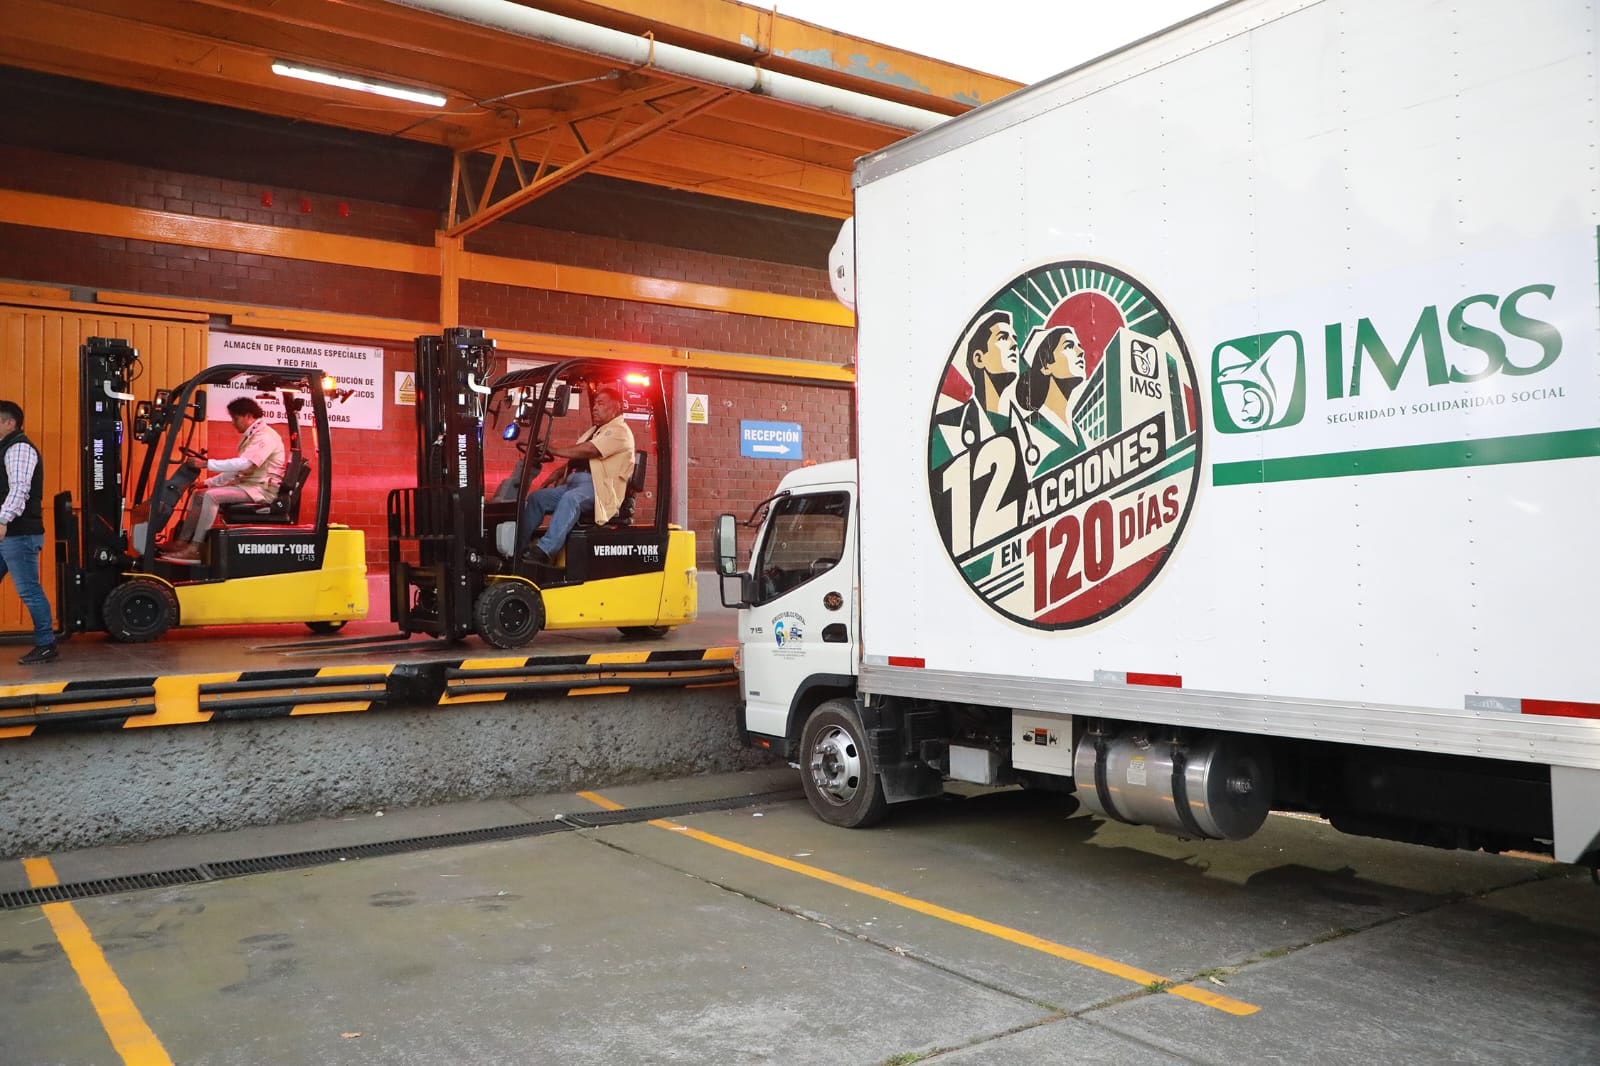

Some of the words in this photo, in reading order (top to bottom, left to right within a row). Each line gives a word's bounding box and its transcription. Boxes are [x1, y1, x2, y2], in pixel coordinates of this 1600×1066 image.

[223, 340, 262, 351] ALMACÉN
[263, 343, 273, 352] DE
[276, 345, 322, 356] PROGRAMAS
[324, 349, 367, 360] ESPECIALES
[1324, 283, 1563, 400] IMSS
[276, 358, 282, 366] Y
[283, 359, 299, 367] RED
[301, 359, 318, 368] FRÍA
[365, 378, 374, 386] DE
[1129, 377, 1163, 400] IMSS
[1326, 407, 1396, 424] SEGURIDAD
[1399, 406, 1408, 416] Y
[1411, 393, 1505, 415] SOLIDARIDAD
[1511, 387, 1566, 403] SOCIAL
[743, 429, 799, 443] RECEPCIÓN
[942, 435, 1019, 558] 12
[1022, 423, 1160, 526] ACCIONES
[237, 543, 316, 554] VERMONT-YORK
[593, 545, 659, 556] VERMONT-YORK
[1001, 538, 1022, 568] EN
[1026, 499, 1115, 613] 120
[1119, 484, 1179, 550] DÍAS
